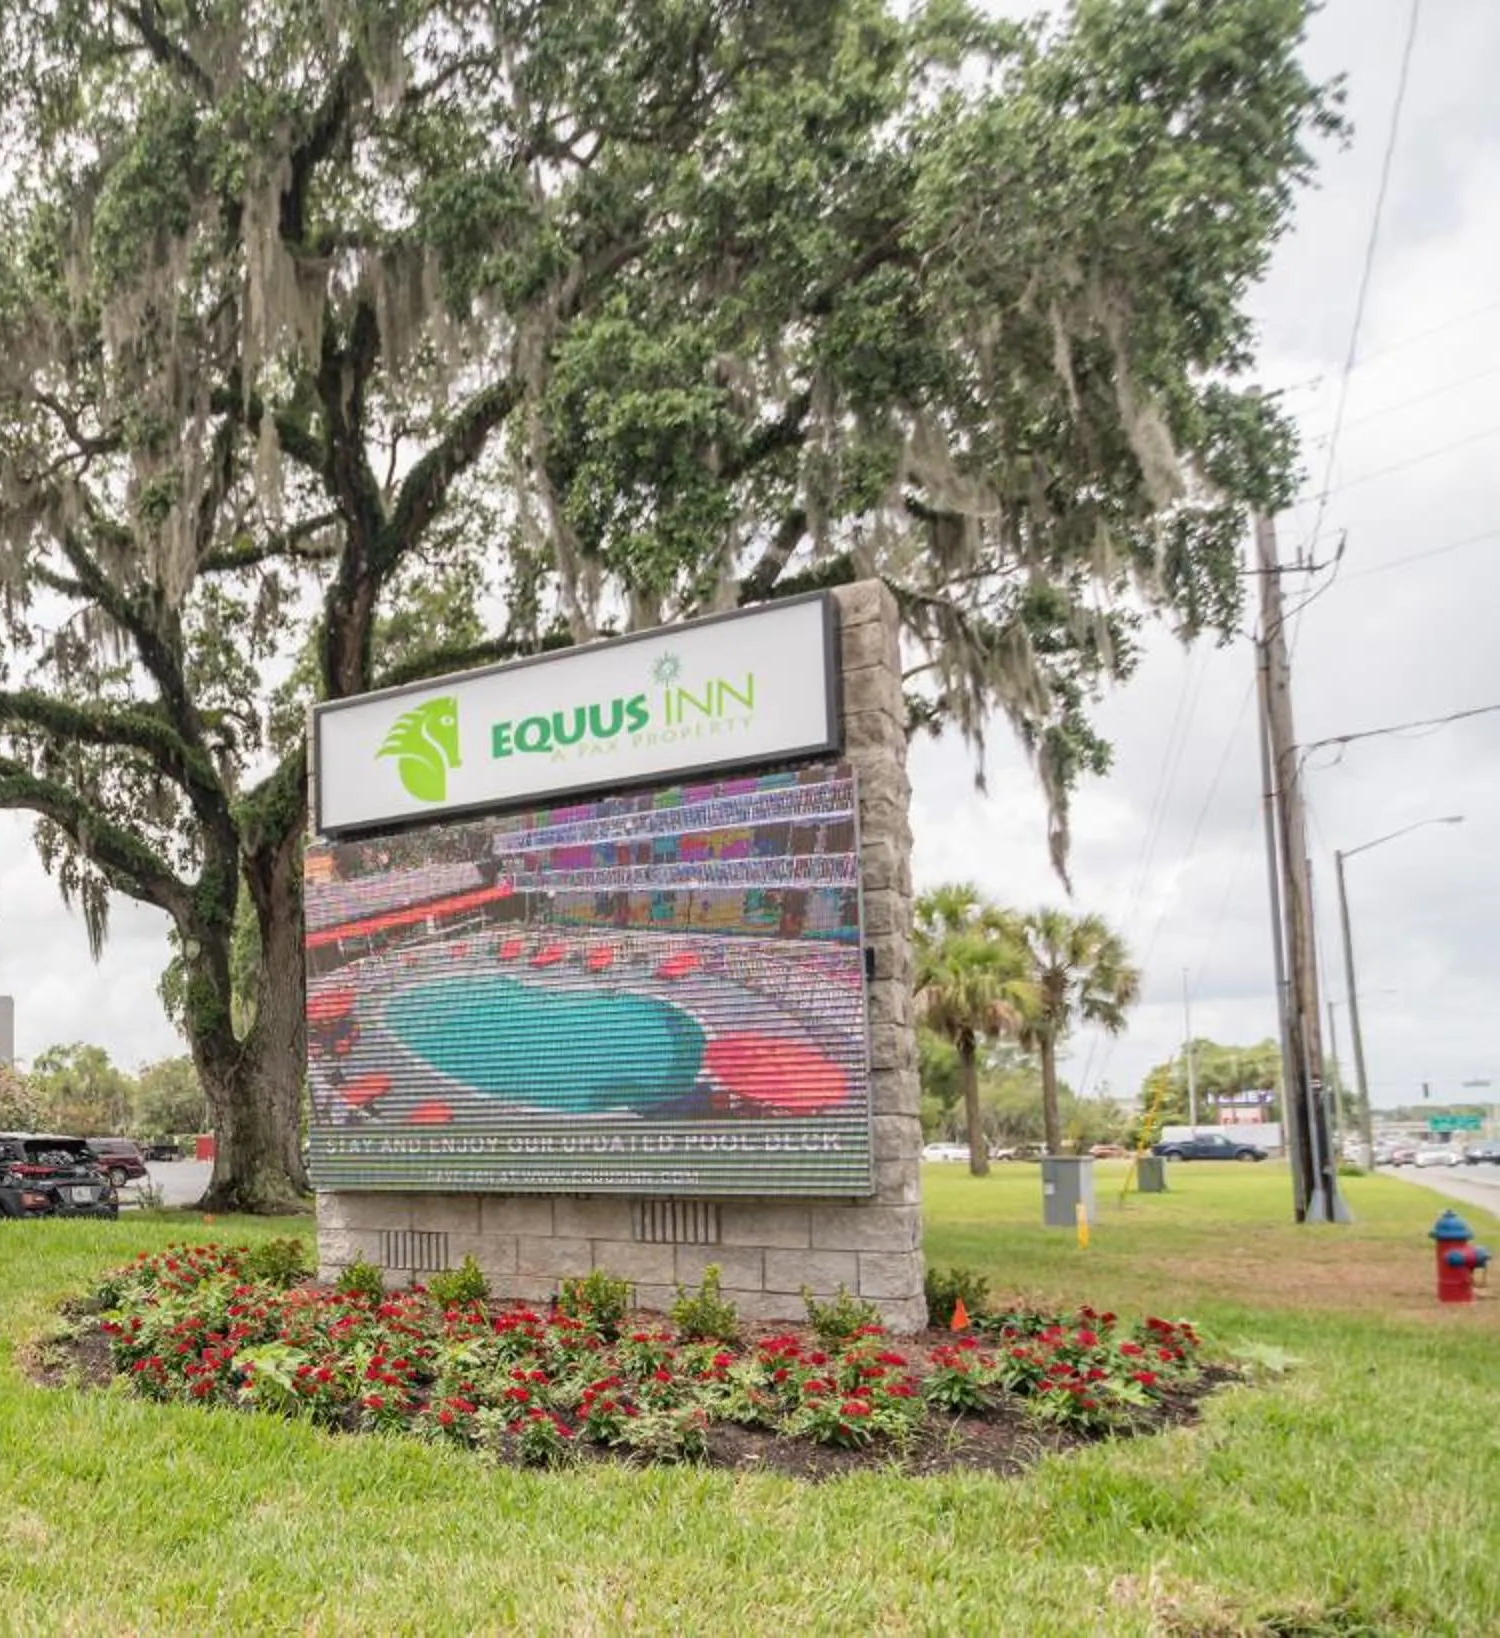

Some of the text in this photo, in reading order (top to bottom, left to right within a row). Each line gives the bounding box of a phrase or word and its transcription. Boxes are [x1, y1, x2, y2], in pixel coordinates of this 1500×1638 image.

[491, 672, 753, 758] EQUUS INN
[579, 742, 617, 758] PAX
[632, 716, 752, 748] PROPERTY
[325, 1133, 841, 1152] STAY AND ENJOY OUR UPDATED POOL DECK
